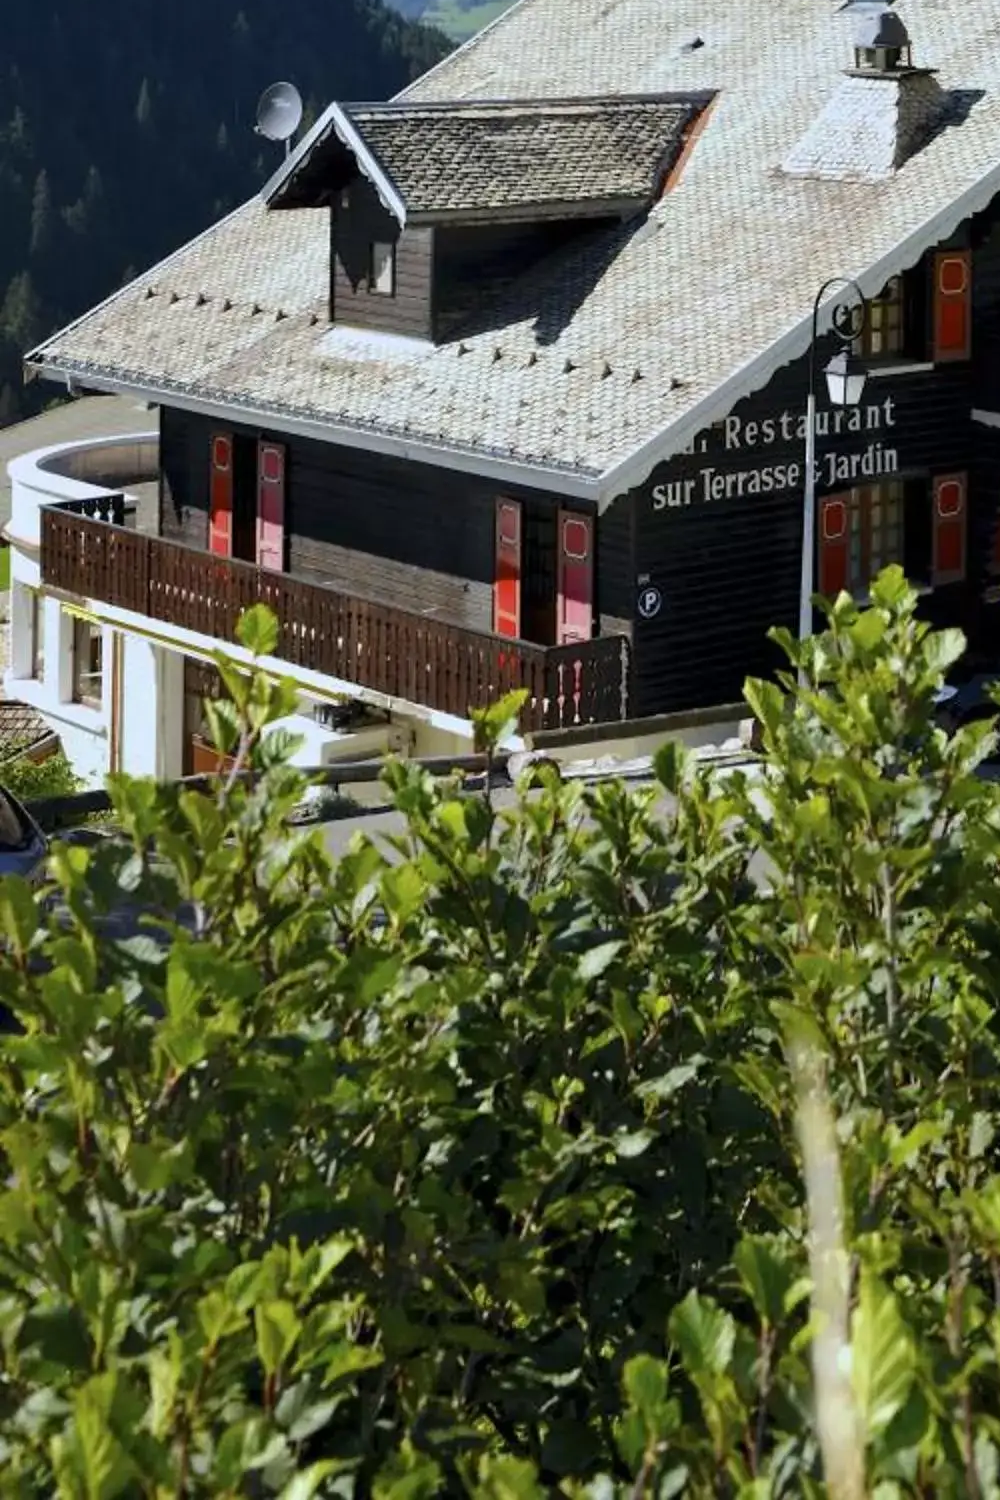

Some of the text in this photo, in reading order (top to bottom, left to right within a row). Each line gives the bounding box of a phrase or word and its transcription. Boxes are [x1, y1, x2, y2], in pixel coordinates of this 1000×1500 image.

[724, 395, 896, 450] Restaurant
[652, 478, 696, 510] sur
[700, 462, 800, 501] Terrasse
[824, 442, 898, 487] Jardin
